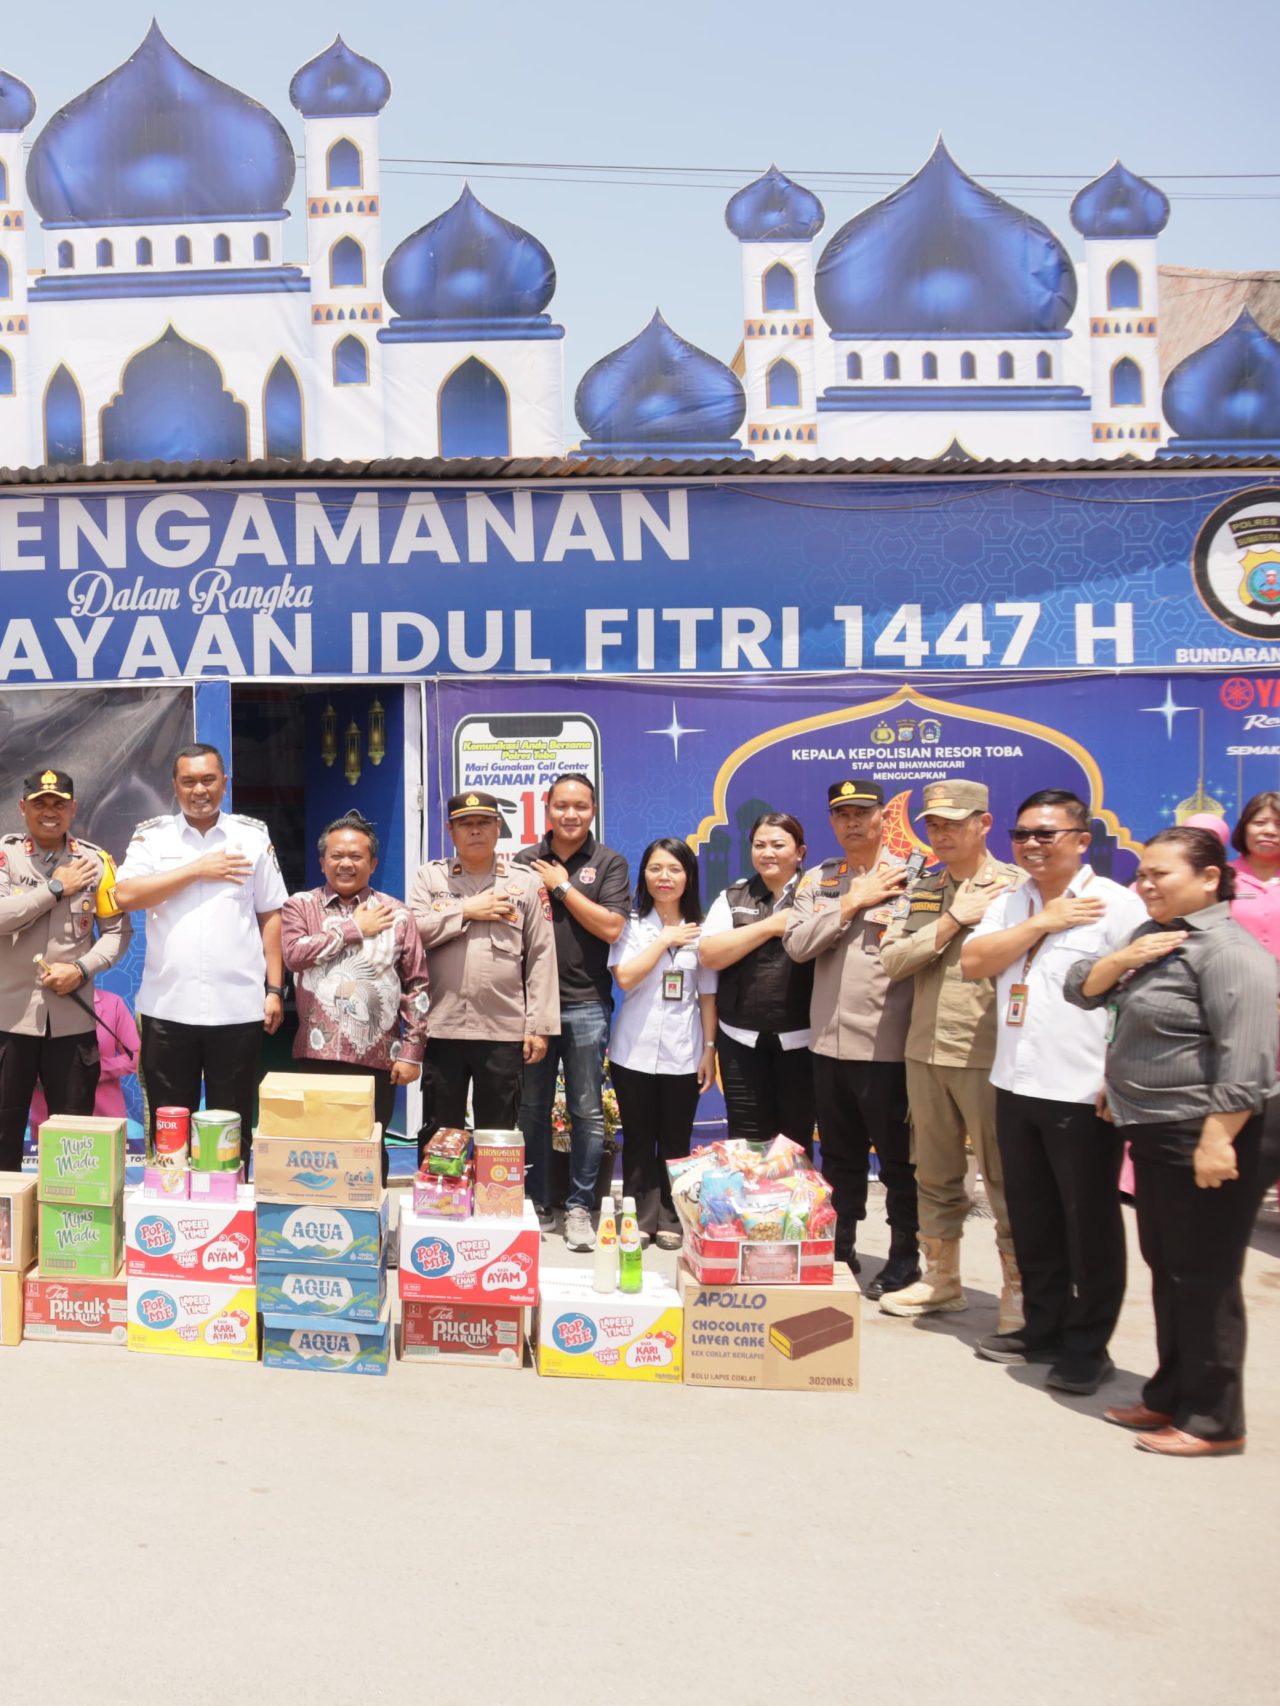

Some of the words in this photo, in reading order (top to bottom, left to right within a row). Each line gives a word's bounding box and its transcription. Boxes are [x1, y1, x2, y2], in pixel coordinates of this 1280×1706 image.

[1232, 518, 1277, 530] POLRES
[67, 570, 181, 617] Dalam
[189, 568, 313, 615] Rangka
[351, 609, 552, 674] IDUL
[585, 606, 800, 671] FITRI
[833, 602, 1042, 668] 1447
[1076, 602, 1135, 665] H
[1176, 648, 1280, 663] BUNDARAN
[463, 741, 519, 751] Komunikasi
[520, 741, 547, 750] Anda
[549, 740, 592, 749] Bersama
[792, 749, 845, 760] KEPALA
[849, 748, 931, 759] KEPOLISIAN
[935, 747, 981, 758] RESOR
[985, 746, 1023, 757] TOBA
[501, 751, 532, 760] Polres
[533, 751, 556, 760] Toba
[465, 763, 488, 771] Mari
[491, 762, 534, 771] Gunakan
[537, 762, 555, 770] Call
[558, 761, 589, 770] Center
[852, 762, 874, 770] STAF
[876, 762, 897, 770] DAN
[899, 761, 965, 769] BHAYANGKARI
[465, 774, 535, 786] LAYANAN
[873, 772, 946, 780] MENGUCAPKAN
[61, 1136, 94, 1155] Nipis
[57, 1154, 97, 1175] Madu
[286, 1151, 338, 1171] AQUA
[62, 1210, 93, 1228] Nipis
[57, 1228, 97, 1248] Madu
[141, 1222, 163, 1239] POP
[183, 1230, 207, 1240] TIME
[292, 1222, 343, 1242] AQUA
[147, 1231, 172, 1248] MIE
[207, 1252, 239, 1262] AYAM
[416, 1243, 441, 1261] POP
[462, 1250, 487, 1260] TIME
[423, 1253, 450, 1271] MIE
[487, 1272, 521, 1283] AYAM
[45, 1284, 69, 1299] Teh
[292, 1279, 343, 1299] AQUA
[50, 1297, 107, 1320] pucuk
[143, 1297, 166, 1314] POP
[693, 1292, 767, 1310] APOLLO
[60, 1312, 103, 1322] HARUM
[149, 1305, 173, 1322] MIE
[184, 1305, 208, 1315] TIME
[428, 1305, 454, 1320] Teh
[213, 1325, 234, 1333] KARI
[432, 1319, 494, 1341] pucuk
[558, 1320, 583, 1338] POP
[604, 1327, 631, 1337] TIME
[692, 1320, 765, 1333] CHOCOLATE
[212, 1332, 237, 1340] AYAM
[442, 1334, 488, 1344] HARUM
[565, 1329, 593, 1347] MIE
[692, 1335, 730, 1346] LAYER
[734, 1336, 765, 1347] CAKE
[298, 1334, 350, 1354] AQUA
[636, 1347, 658, 1355] KARI
[635, 1355, 661, 1363] AYAM
[809, 1376, 853, 1387] 3020MLS
